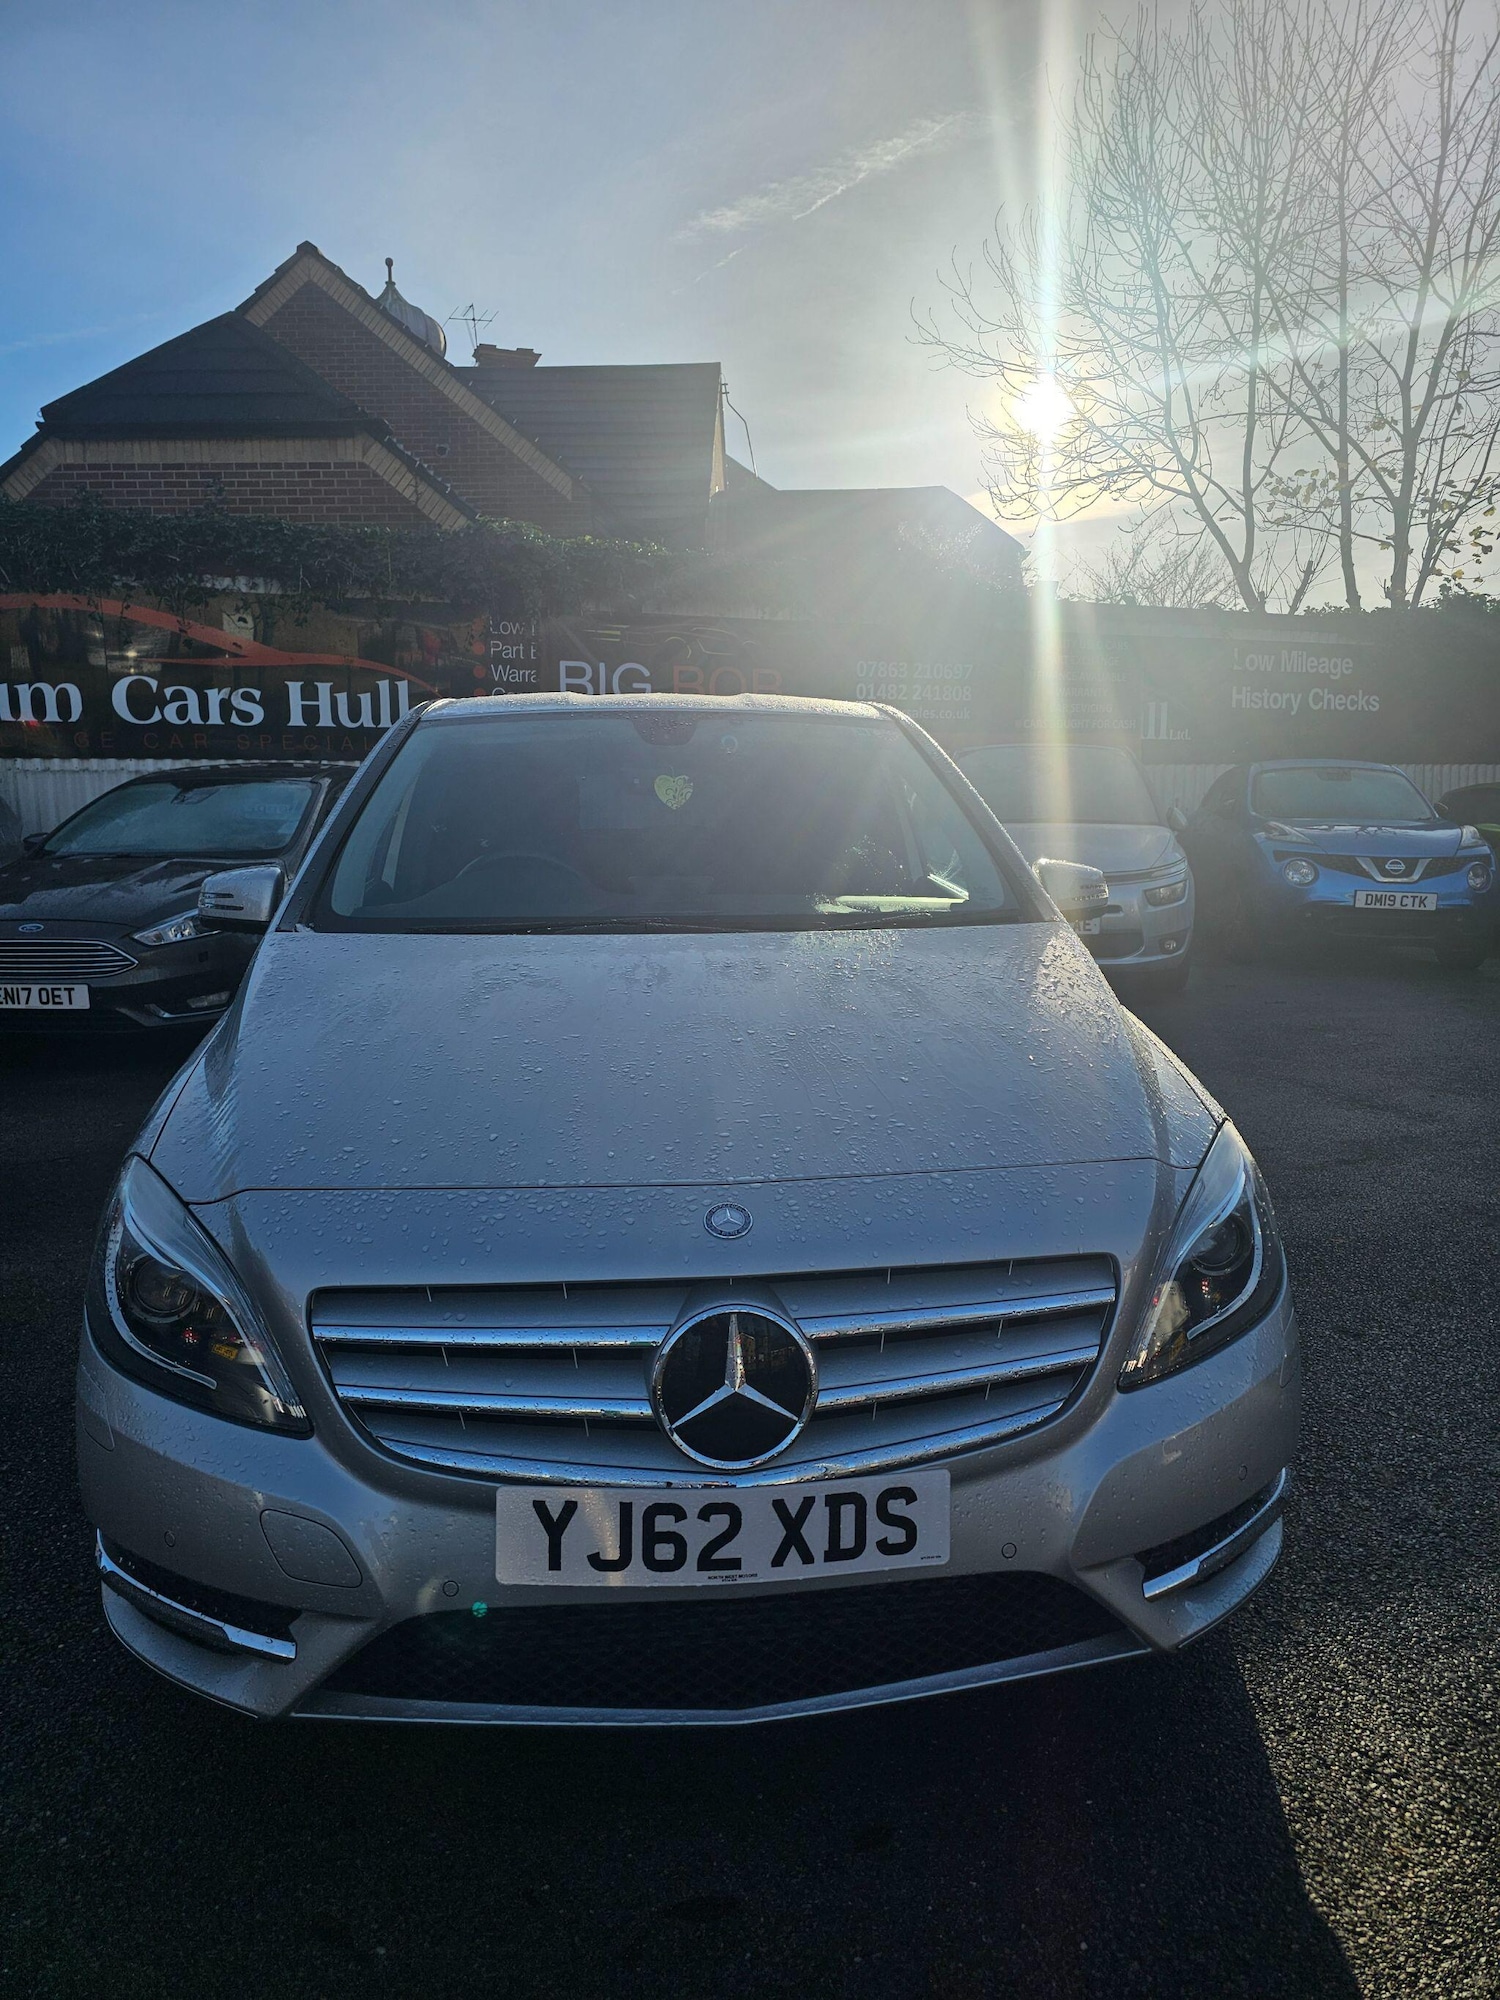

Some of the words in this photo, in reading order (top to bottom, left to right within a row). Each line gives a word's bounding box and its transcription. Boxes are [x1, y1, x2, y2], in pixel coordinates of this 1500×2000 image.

[490, 640, 525, 660] Part
[856, 661, 908, 679] 07863
[913, 662, 974, 680] 210697
[1232, 647, 1275, 672] Low
[1281, 650, 1353, 680] Mileage
[558, 660, 651, 694] BIG
[111, 674, 265, 726] Cars
[284, 678, 410, 729] Hull
[856, 683, 908, 700] 01482
[912, 684, 972, 702] 241808
[1231, 685, 1303, 716] History
[1308, 687, 1381, 712] Checks
[903, 706, 971, 720] sales.co.uk
[1111, 719, 1137, 730] CASH
[144, 733, 209, 749] CAR
[1365, 893, 1396, 906] DM19
[1400, 895, 1428, 908] CTK
[0, 987, 32, 1005] N17
[532, 1499, 742, 1572] YJ62
[771, 1486, 918, 1568] XDS
